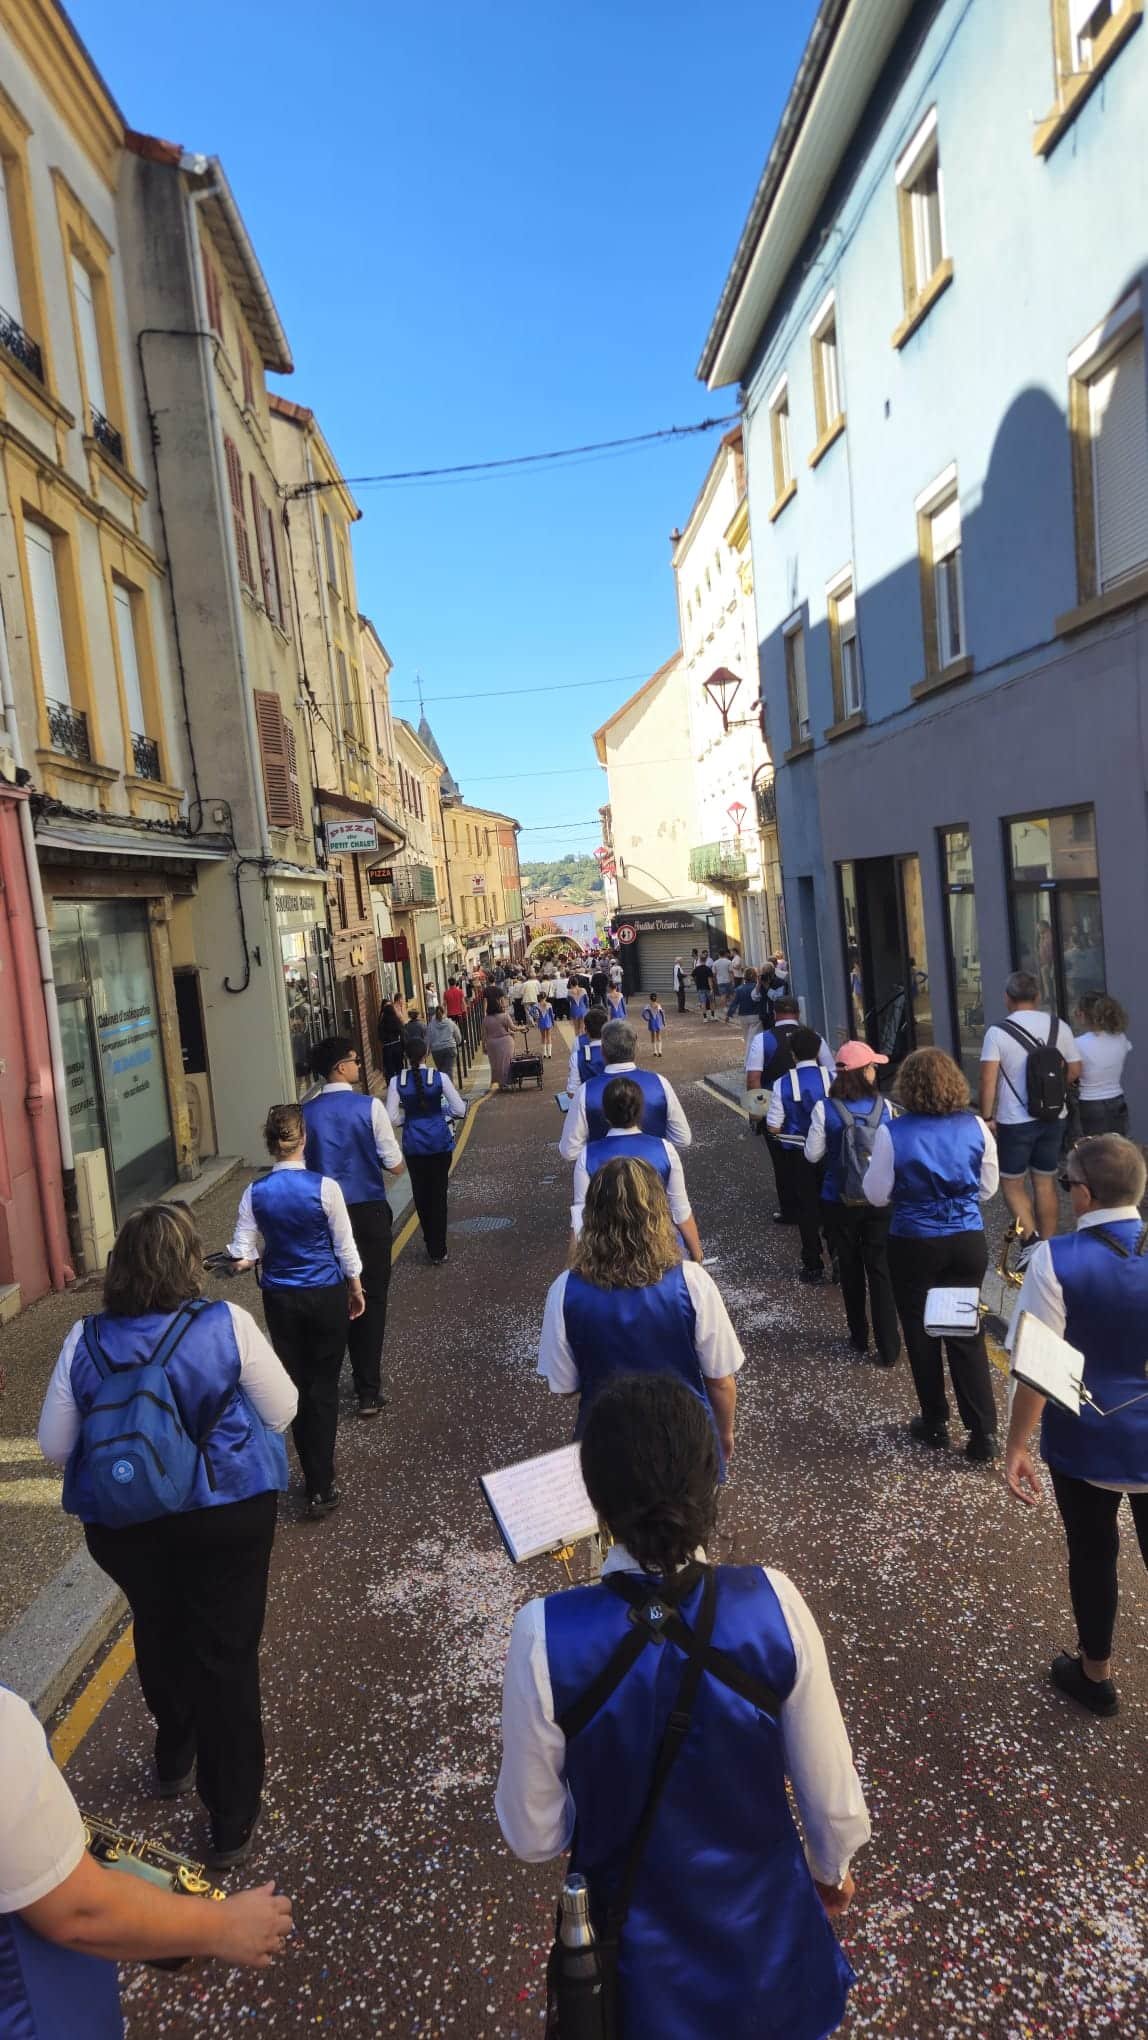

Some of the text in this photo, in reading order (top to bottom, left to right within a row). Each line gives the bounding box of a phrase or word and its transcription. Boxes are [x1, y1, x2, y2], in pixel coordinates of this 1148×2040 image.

[330, 824, 374, 837] PIZZA
[350, 840, 375, 848] CHALET
[369, 869, 391, 878] PIZZA
